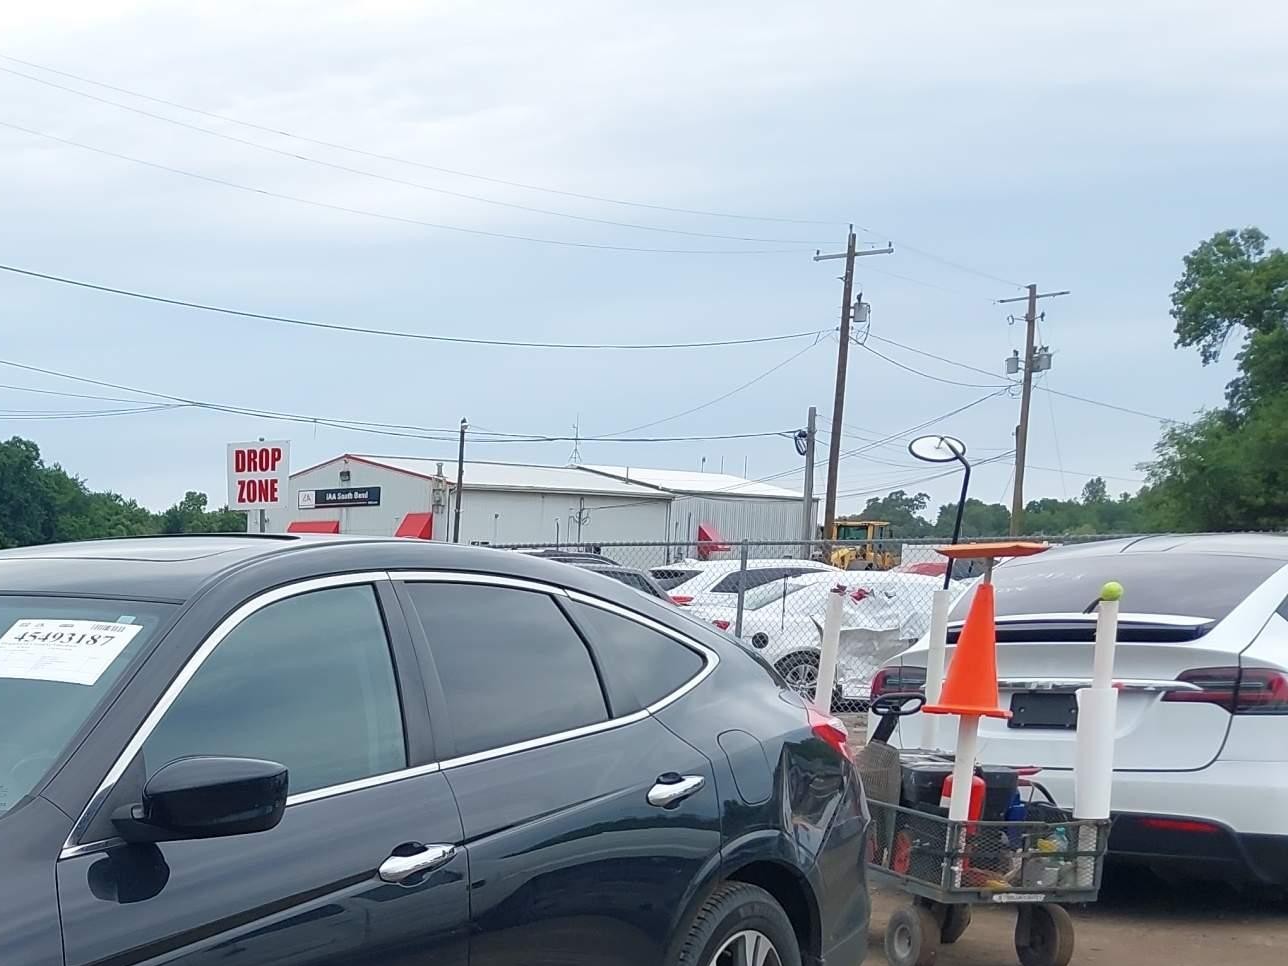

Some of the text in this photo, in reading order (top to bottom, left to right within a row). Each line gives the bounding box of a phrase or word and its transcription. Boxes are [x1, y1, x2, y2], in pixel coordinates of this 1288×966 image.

[235, 447, 281, 472] DROP
[237, 478, 278, 503] ZONE
[14, 631, 115, 646] 45493187
